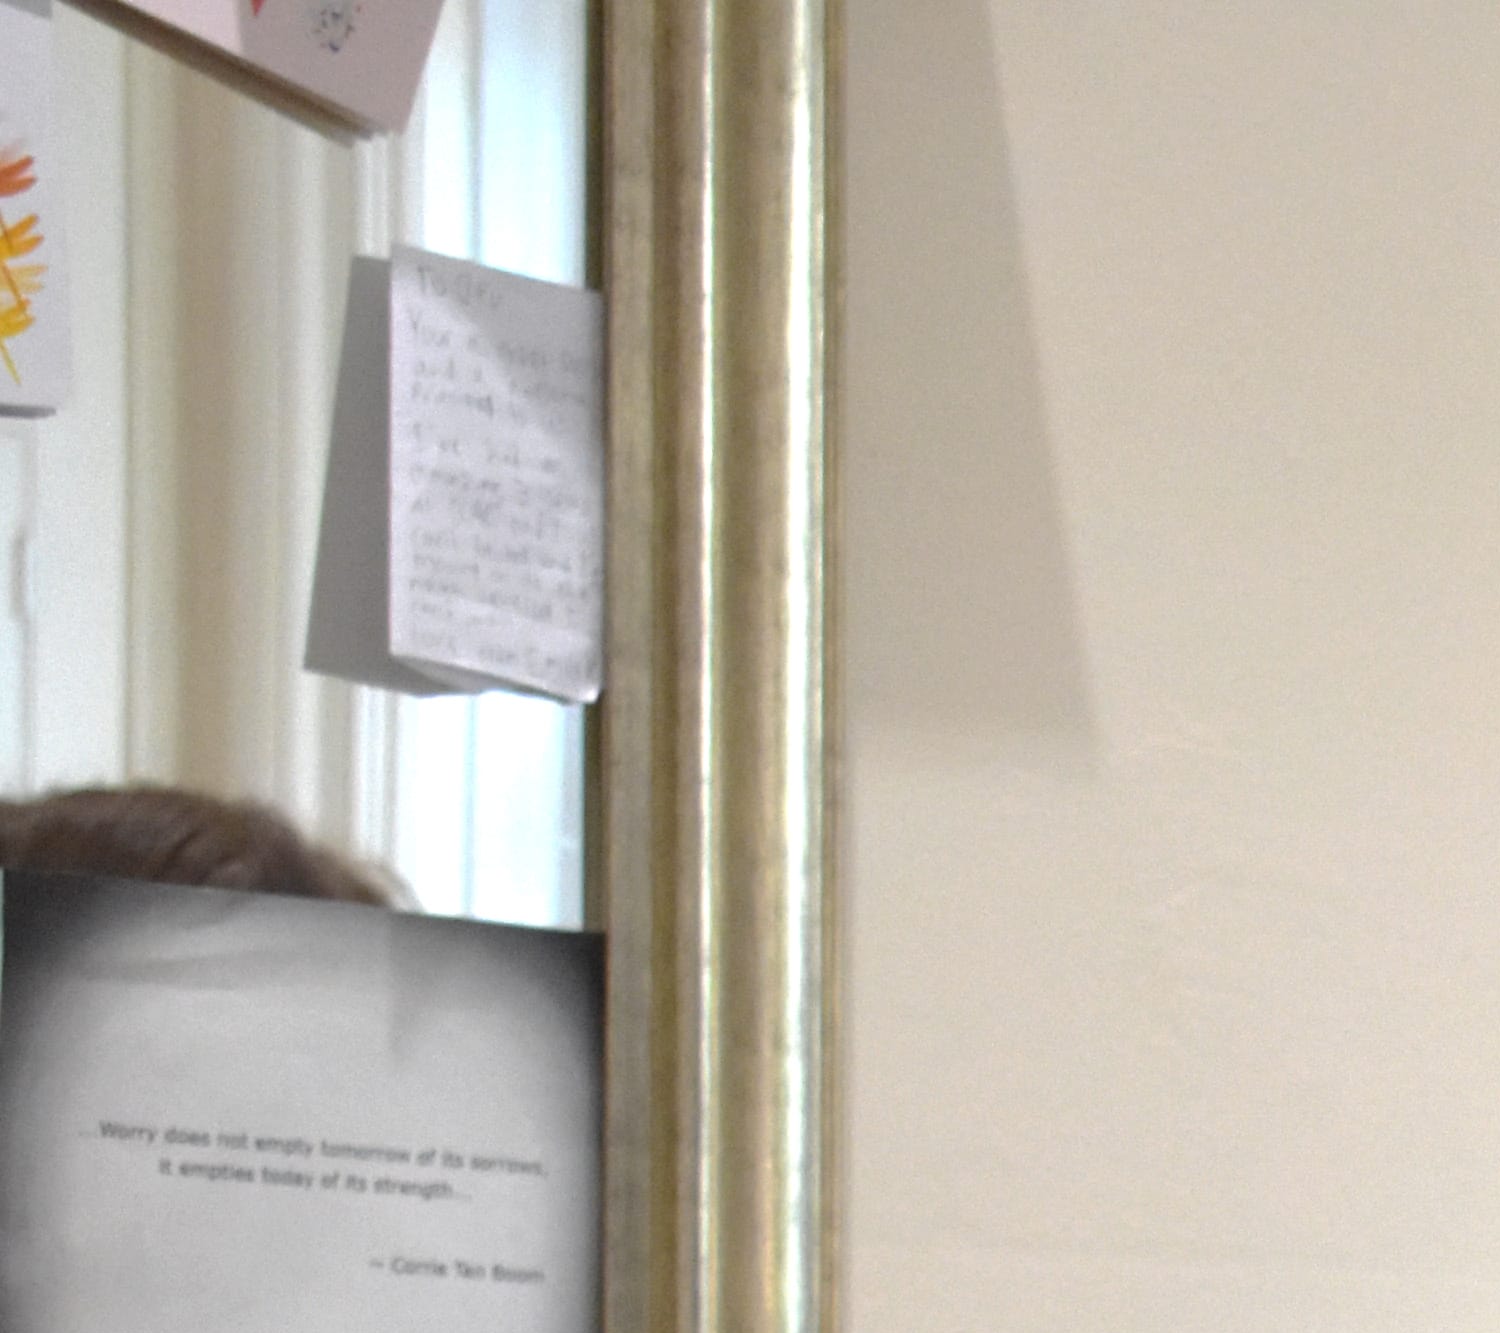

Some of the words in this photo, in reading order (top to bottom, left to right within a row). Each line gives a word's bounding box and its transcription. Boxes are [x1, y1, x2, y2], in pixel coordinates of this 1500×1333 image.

[165, 1128, 210, 1147] does
[218, 1133, 248, 1149] not
[255, 1137, 313, 1157] empty
[321, 1139, 410, 1162] tomorrow
[416, 1149, 436, 1166] of
[442, 1151, 464, 1168] its
[179, 1163, 255, 1182] empties
[262, 1167, 313, 1187] today
[321, 1172, 339, 1189] of
[346, 1175, 367, 1193] its
